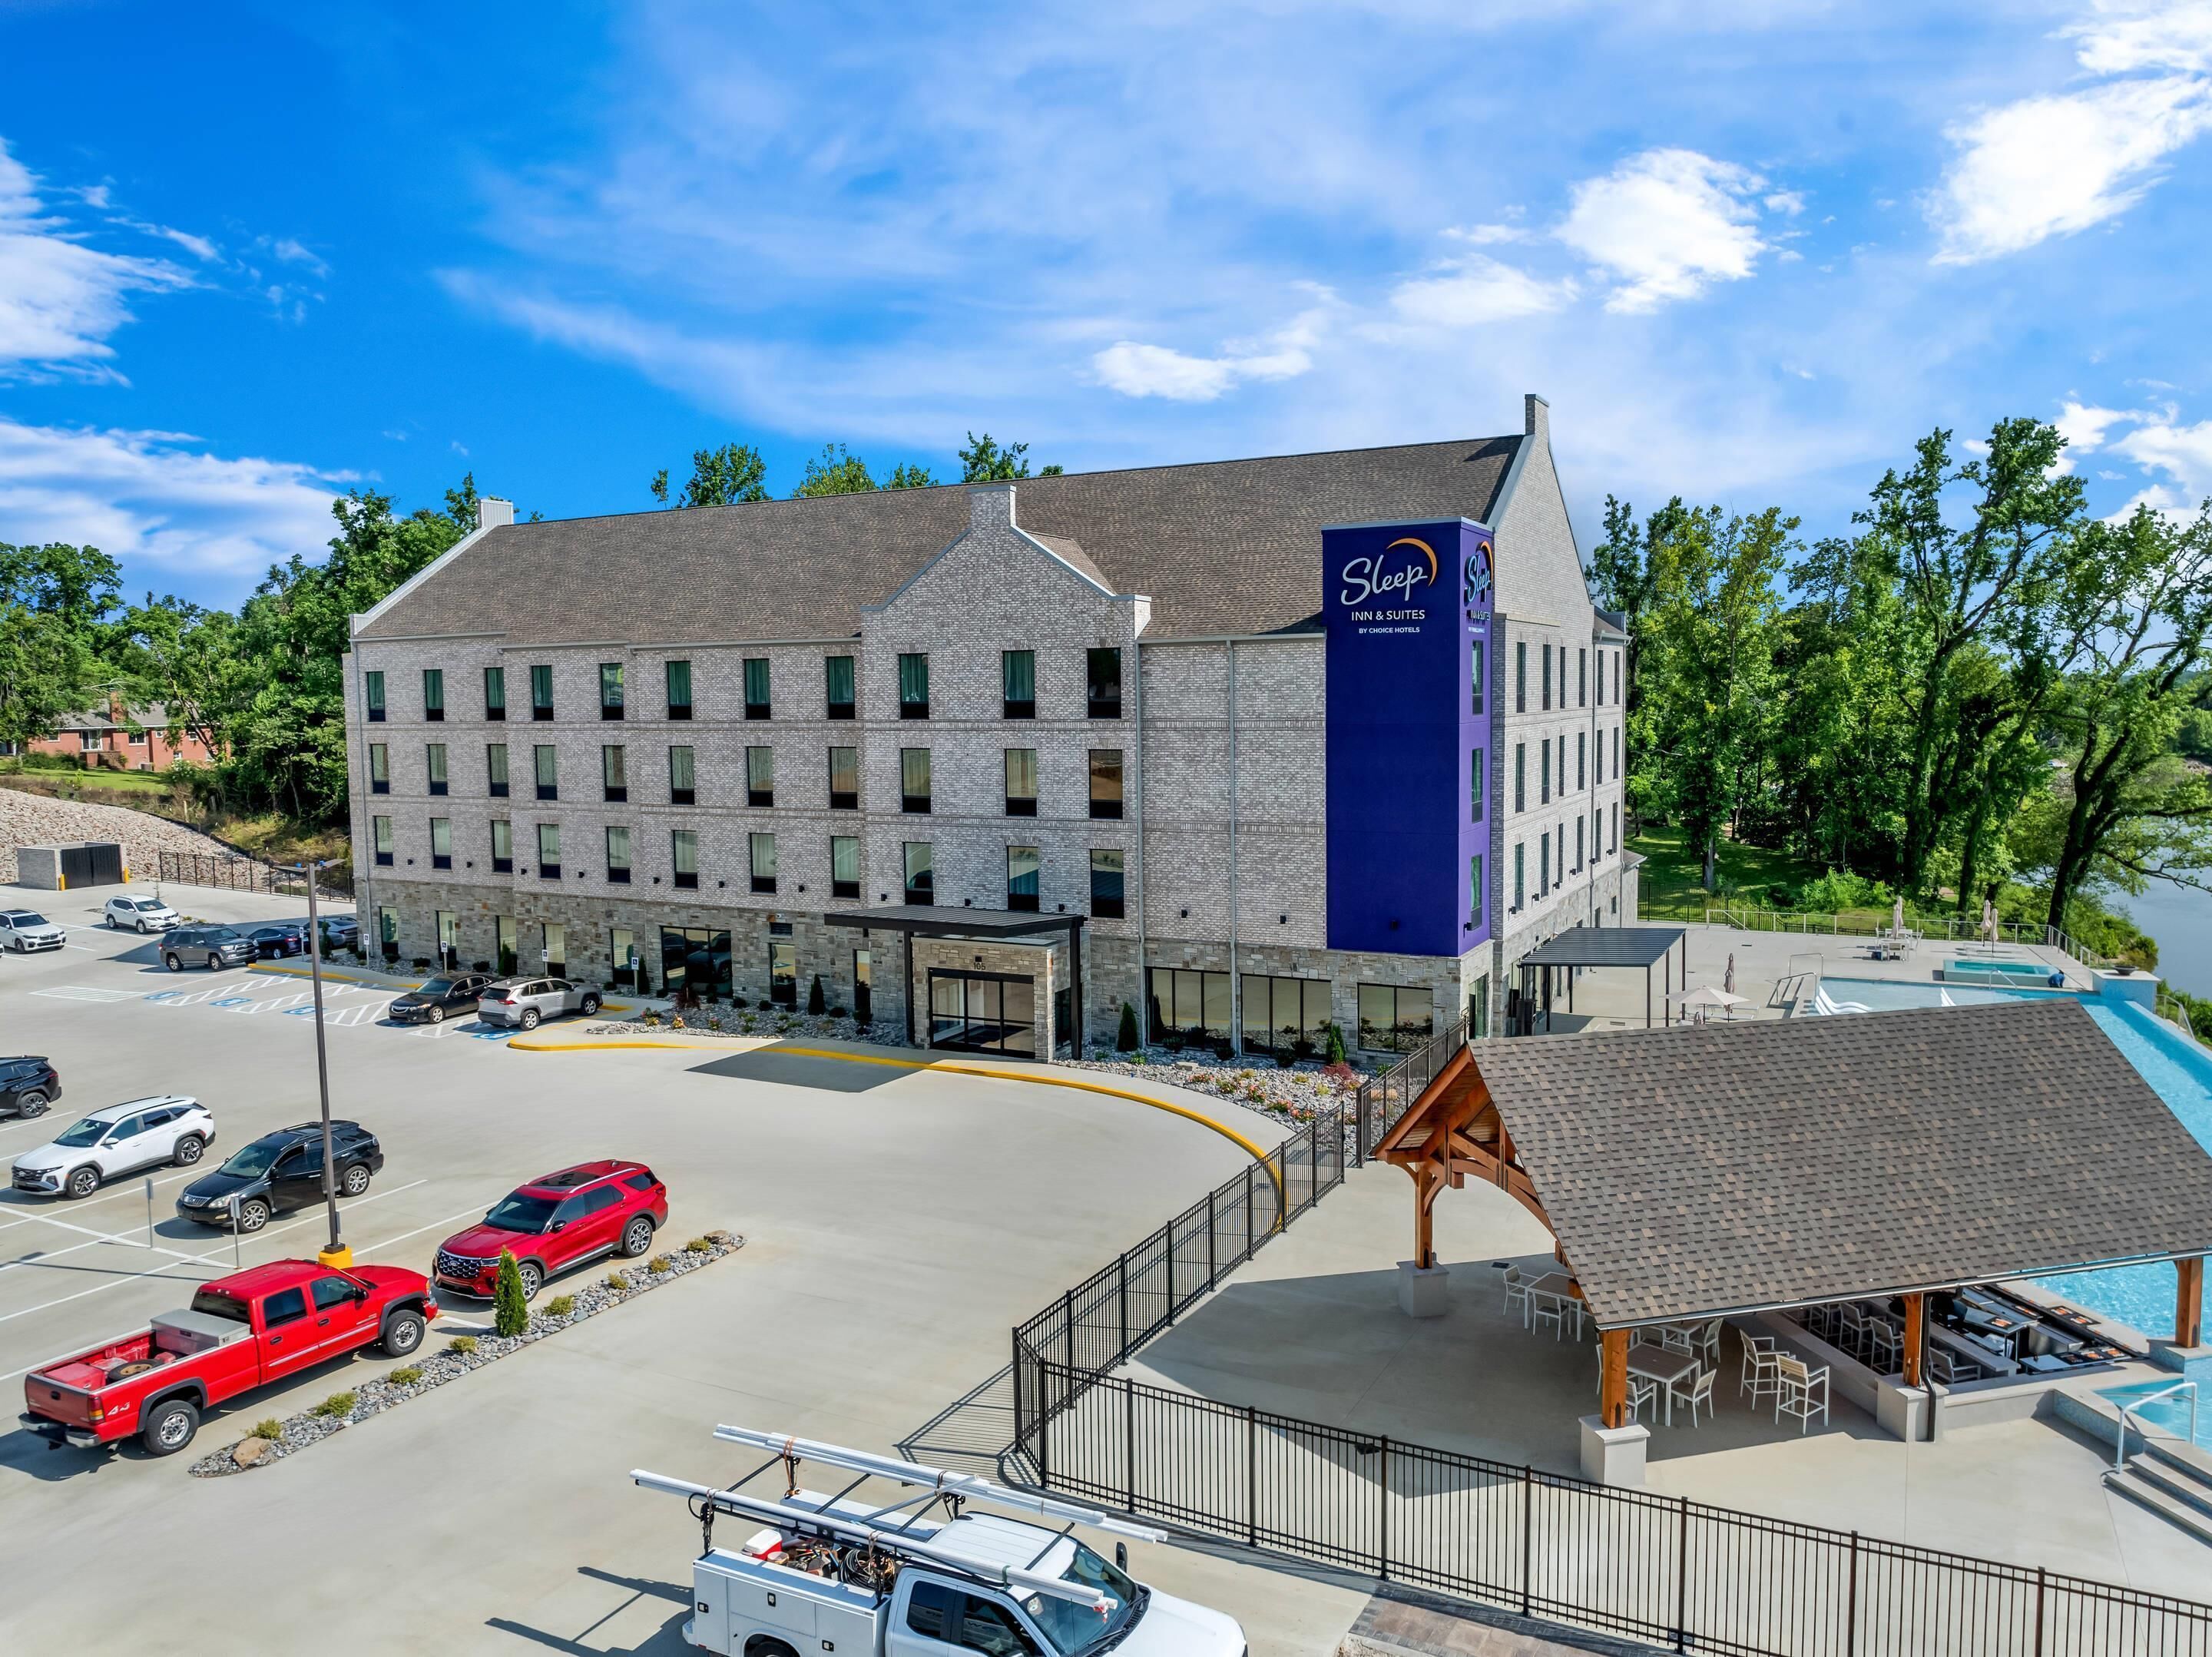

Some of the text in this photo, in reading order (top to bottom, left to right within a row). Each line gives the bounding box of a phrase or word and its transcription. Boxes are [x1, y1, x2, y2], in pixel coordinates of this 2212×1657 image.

[1341, 555, 1428, 605] Sleep
[1469, 555, 1491, 602] Sleep
[1352, 610, 1426, 621] INN & SUITES
